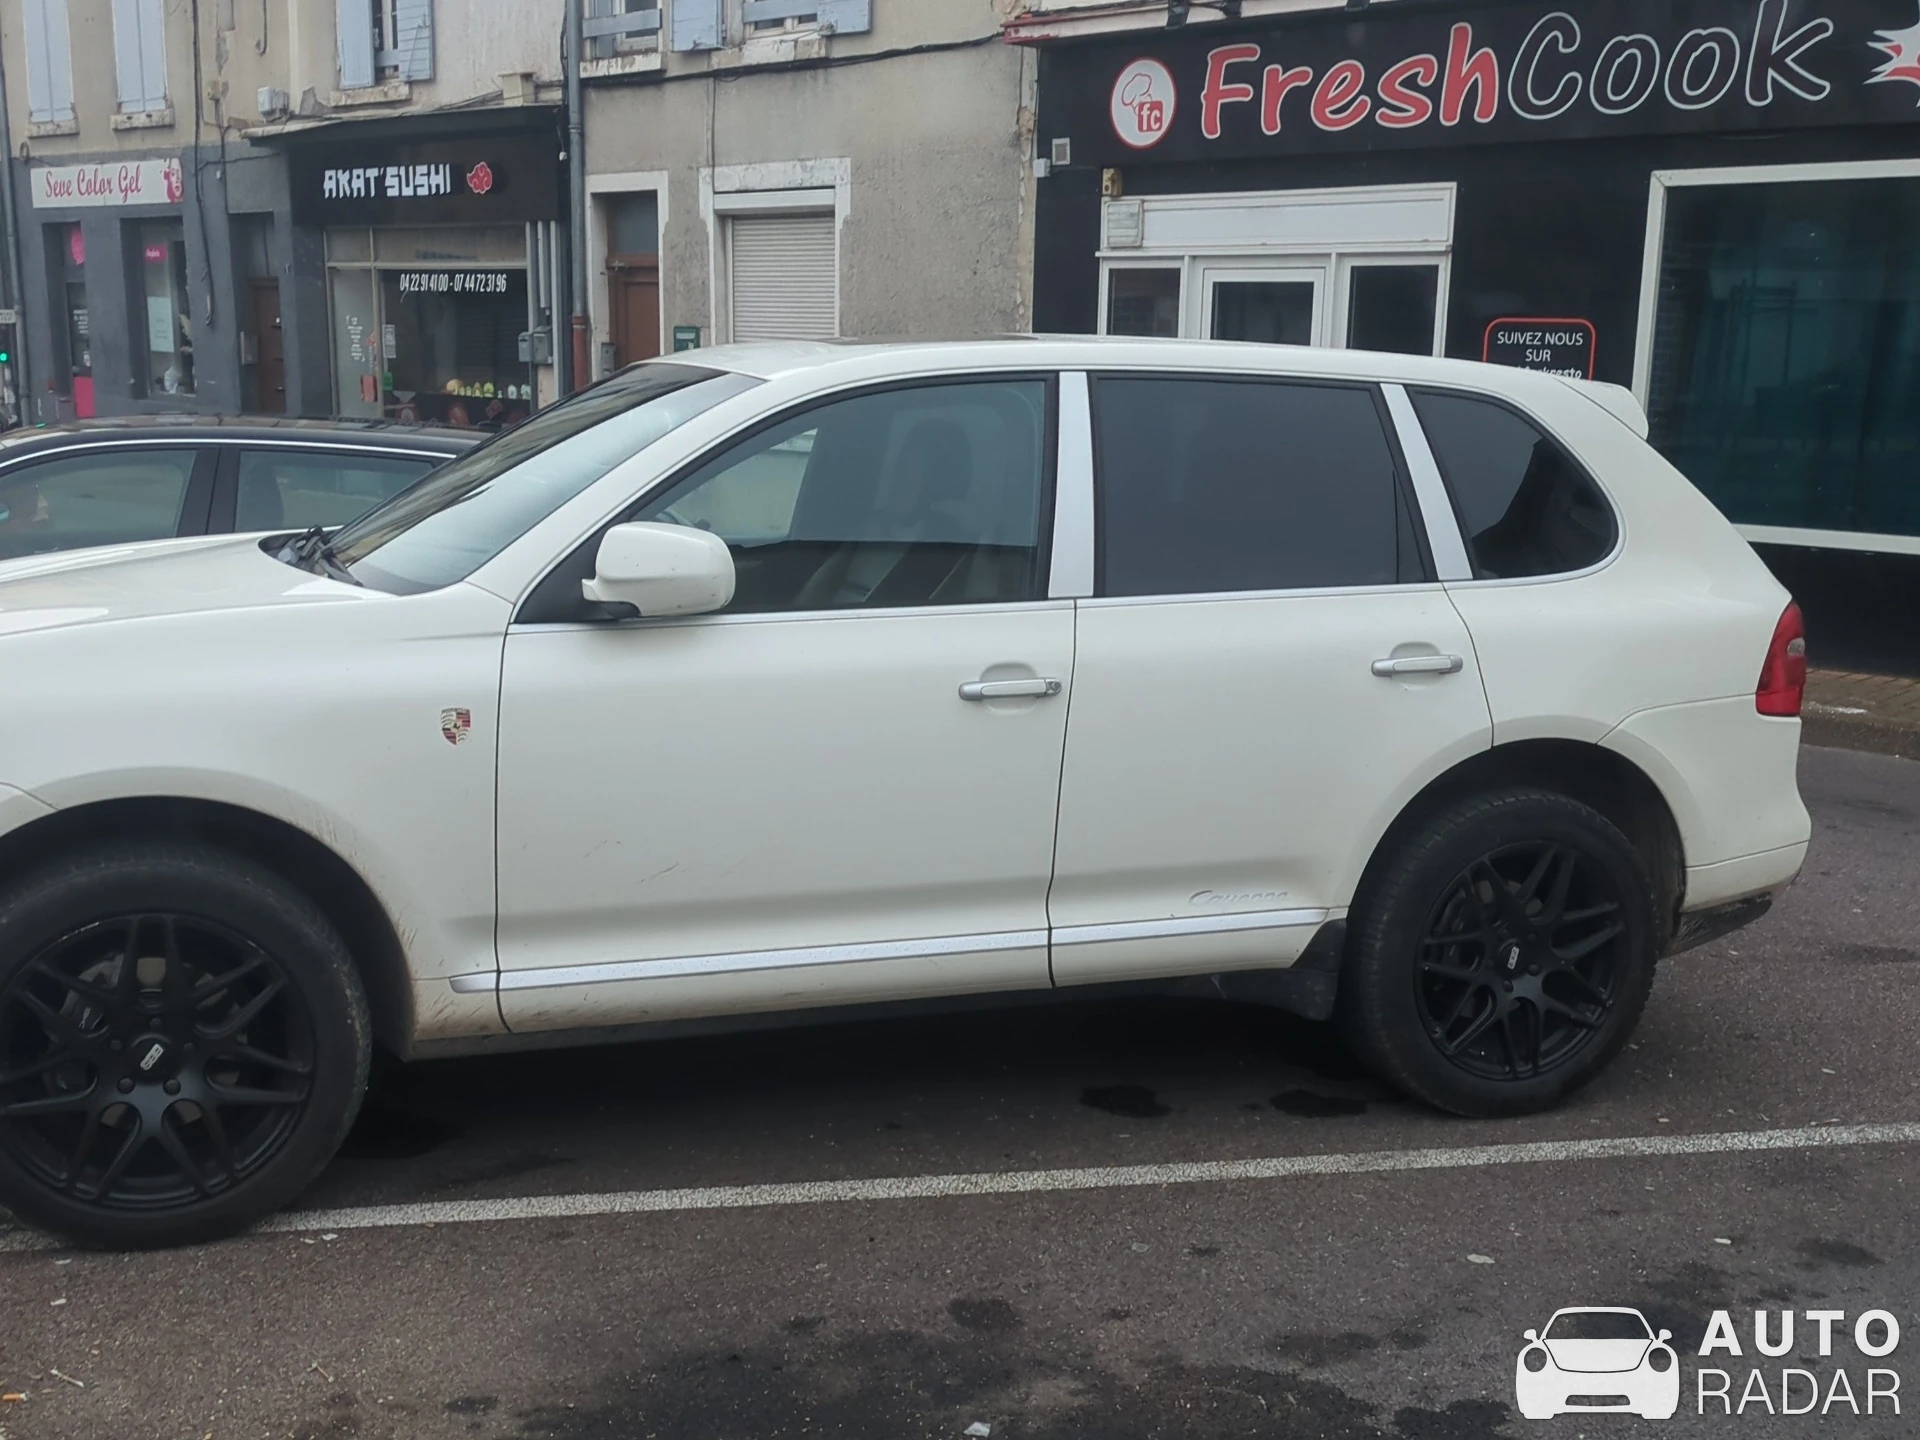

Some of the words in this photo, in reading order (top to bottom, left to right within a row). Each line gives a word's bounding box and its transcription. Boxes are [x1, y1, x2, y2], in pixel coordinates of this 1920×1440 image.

[1201, 0, 1834, 139] FreshCook
[1140, 102, 1161, 132] fc
[77, 167, 114, 196] Color
[118, 164, 142, 203] Gel
[1496, 331, 1542, 345] SUIVEZ
[1545, 332, 1584, 346] NOUS
[1525, 349, 1551, 362] SUR
